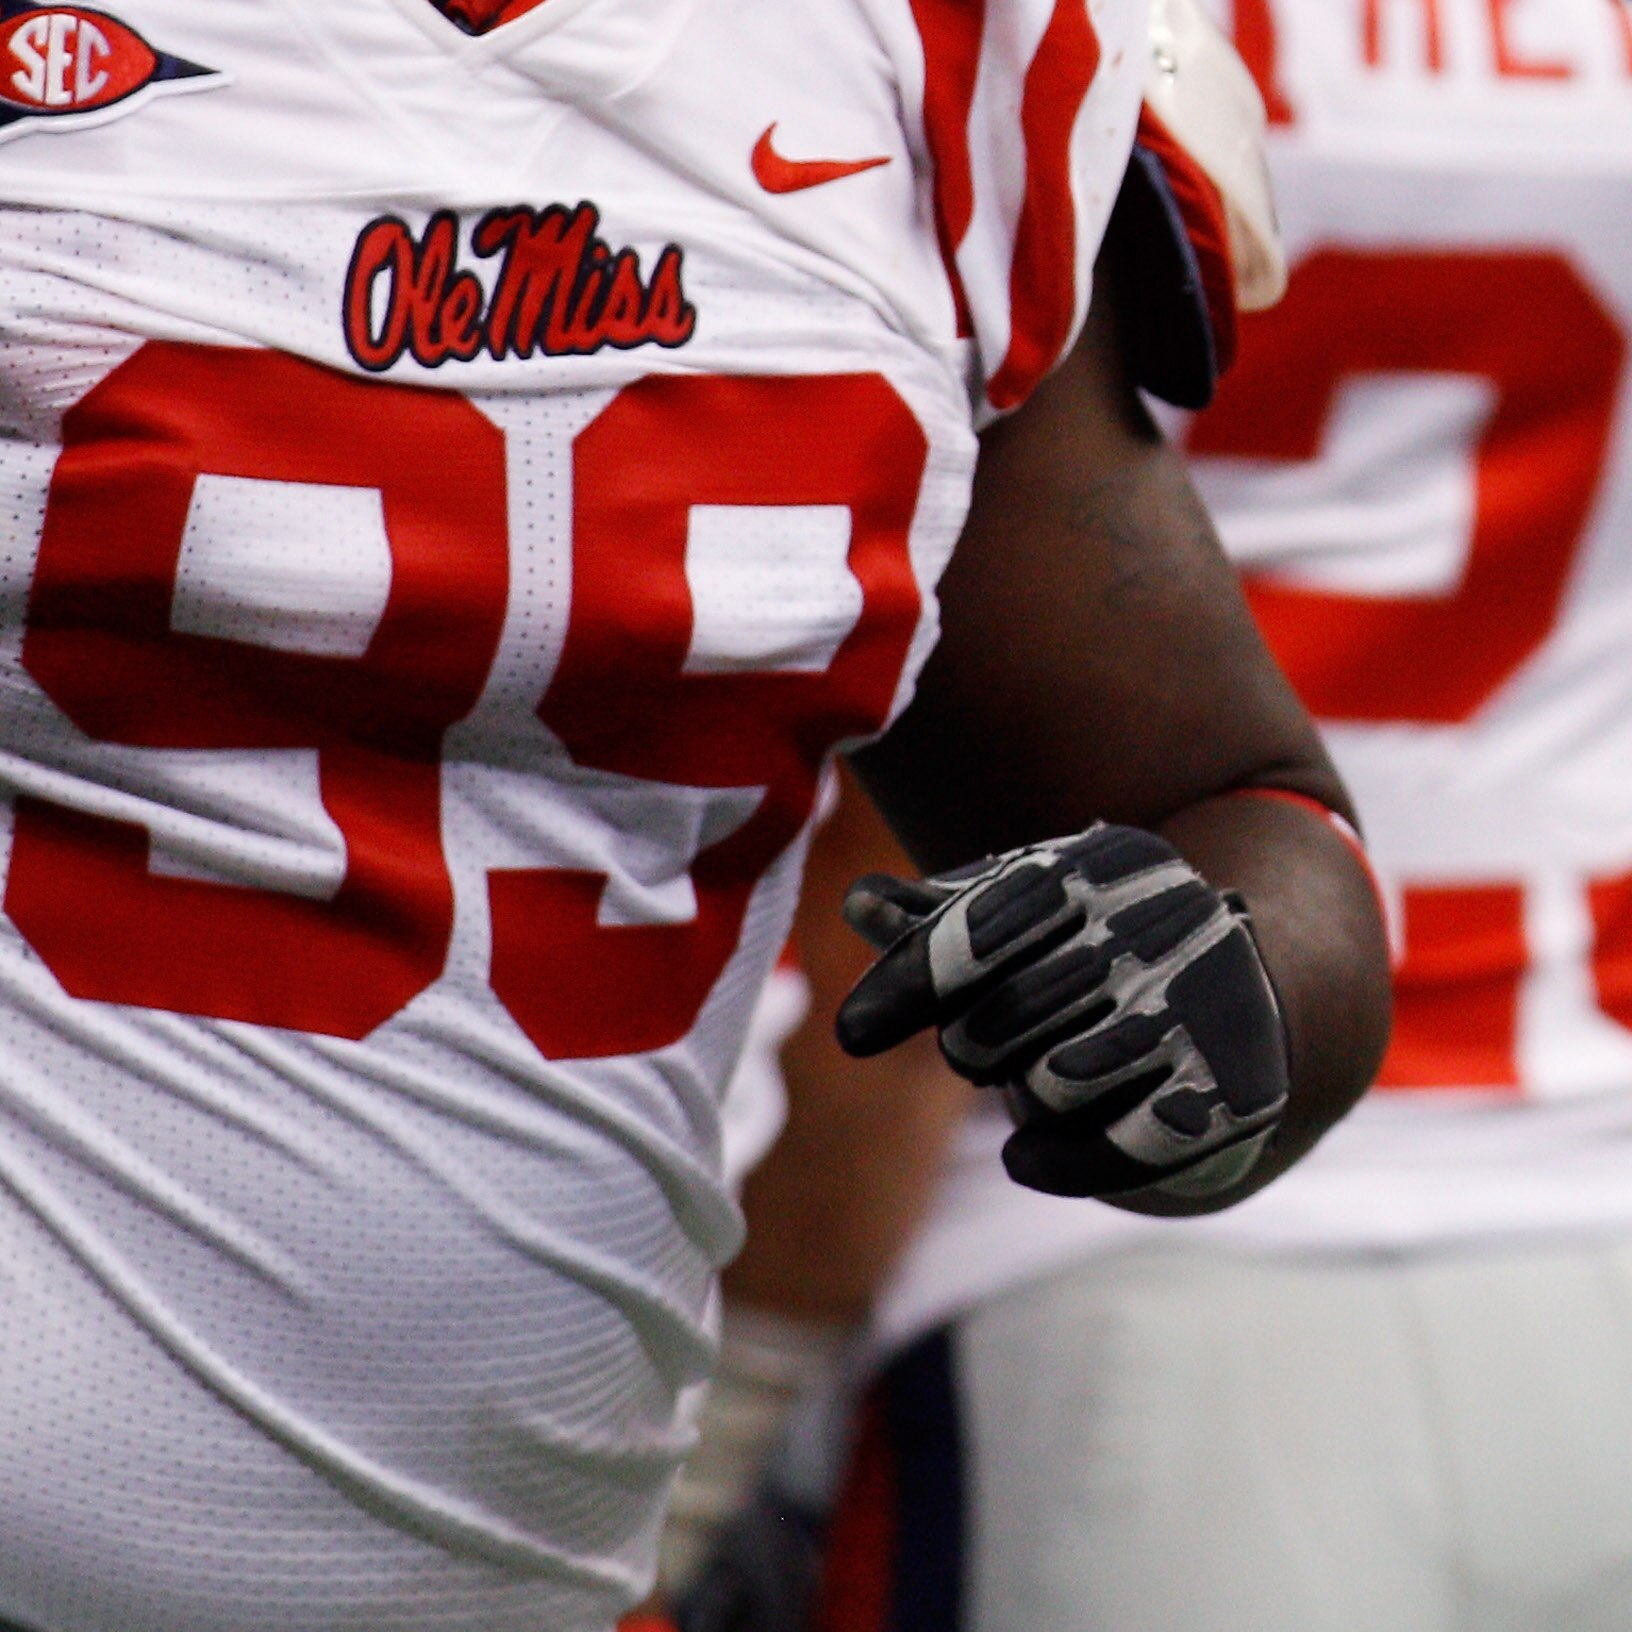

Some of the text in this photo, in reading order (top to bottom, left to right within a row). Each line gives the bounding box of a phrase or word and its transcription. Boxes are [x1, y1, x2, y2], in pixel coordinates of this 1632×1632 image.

[8, 13, 112, 106] SEC
[342, 199, 697, 372] Ole Miss
[0, 336, 932, 1062] 99
